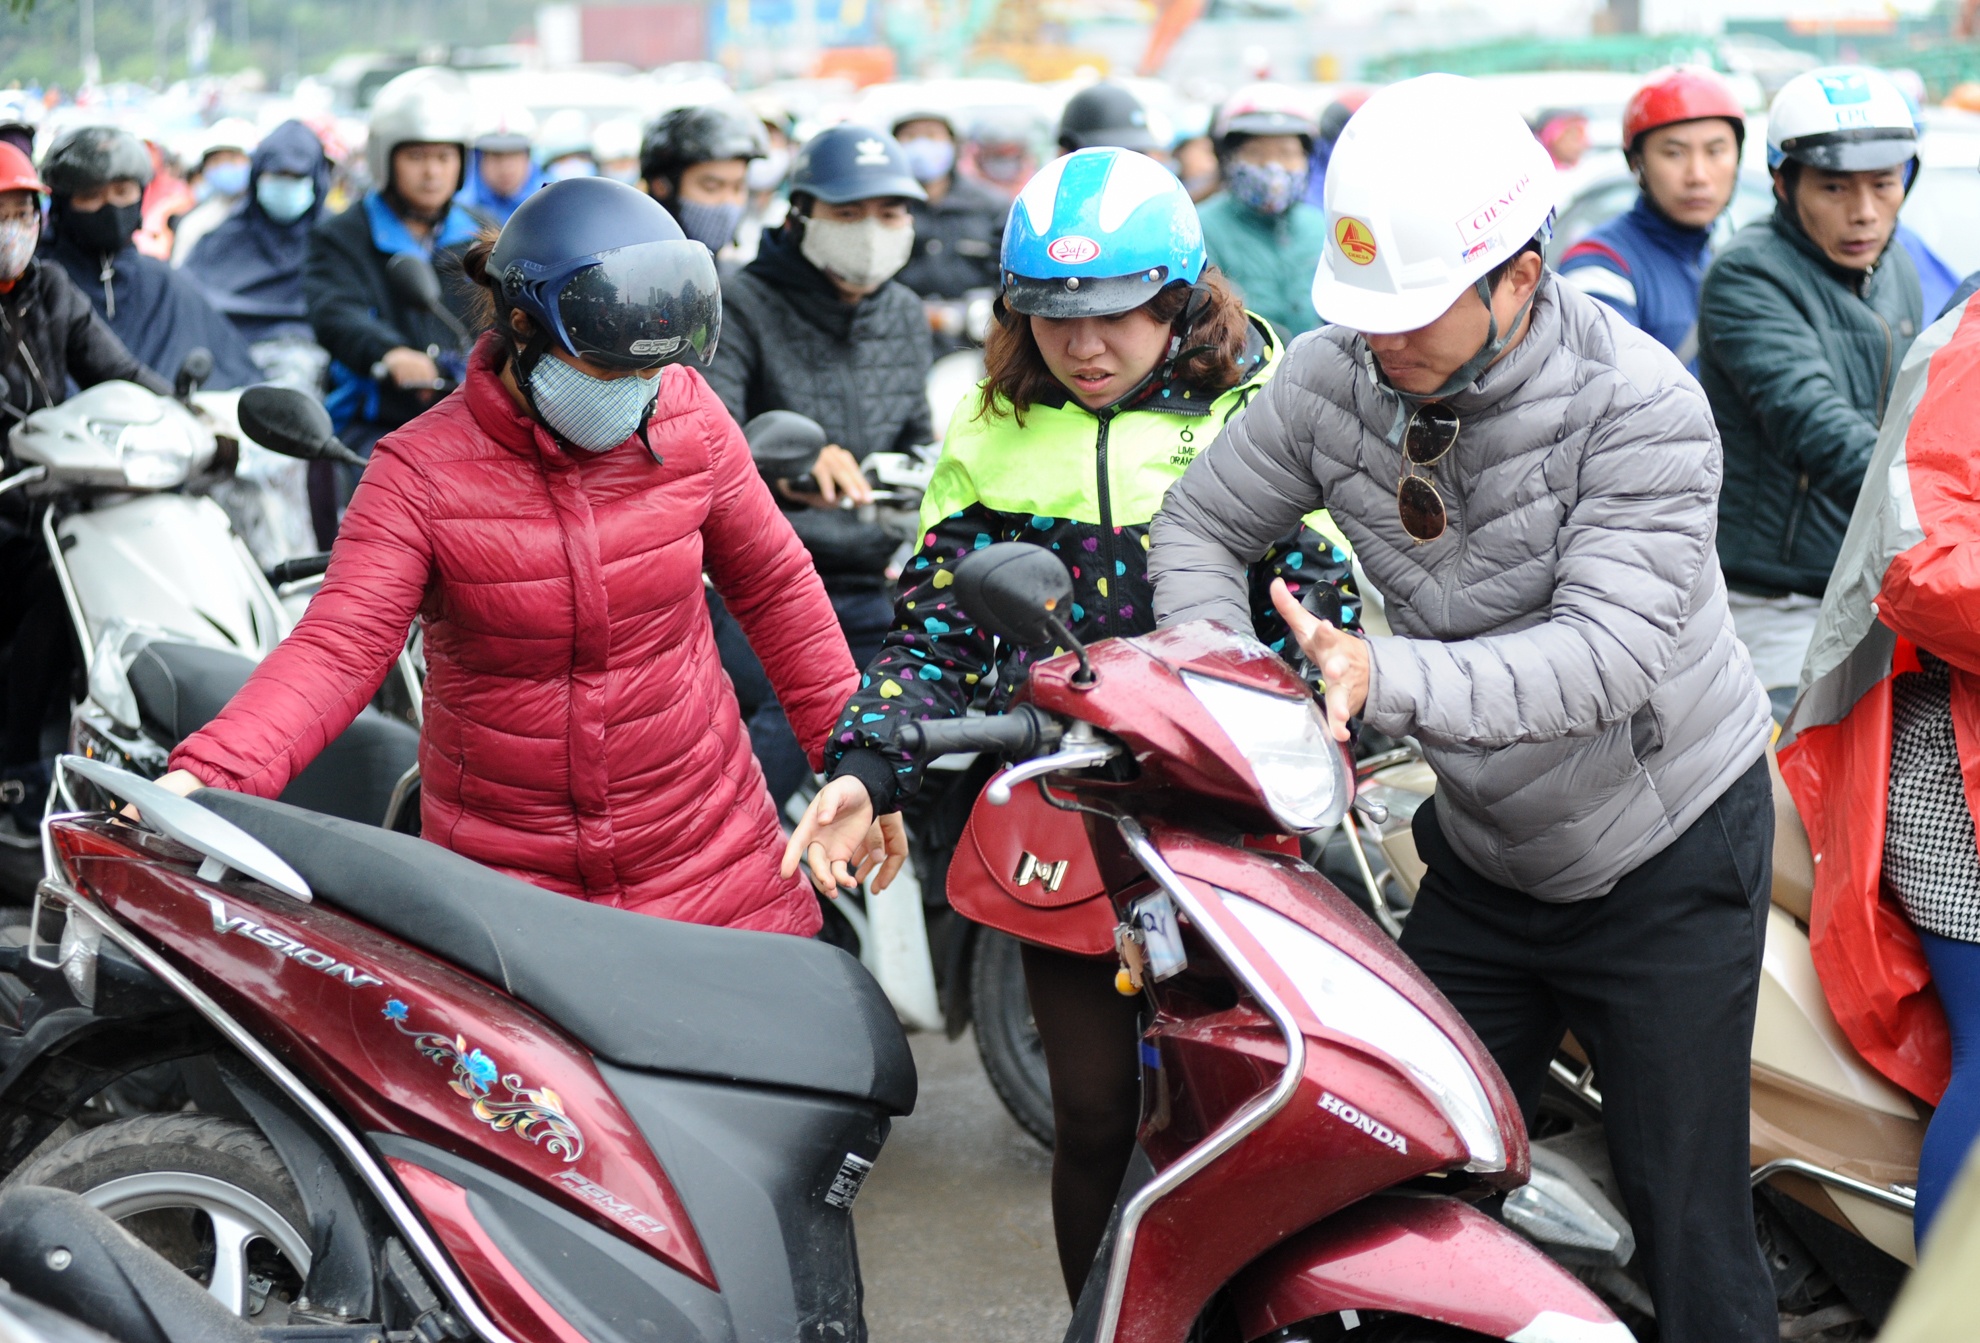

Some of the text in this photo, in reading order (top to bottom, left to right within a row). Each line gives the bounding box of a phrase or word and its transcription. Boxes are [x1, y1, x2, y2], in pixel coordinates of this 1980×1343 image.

[1056, 240, 1088, 260] Safe
[1170, 455, 1194, 466] ORAN
[1177, 446, 1196, 456] LIME
[194, 889, 384, 987] VISION
[1317, 1091, 1408, 1155] HONDA
